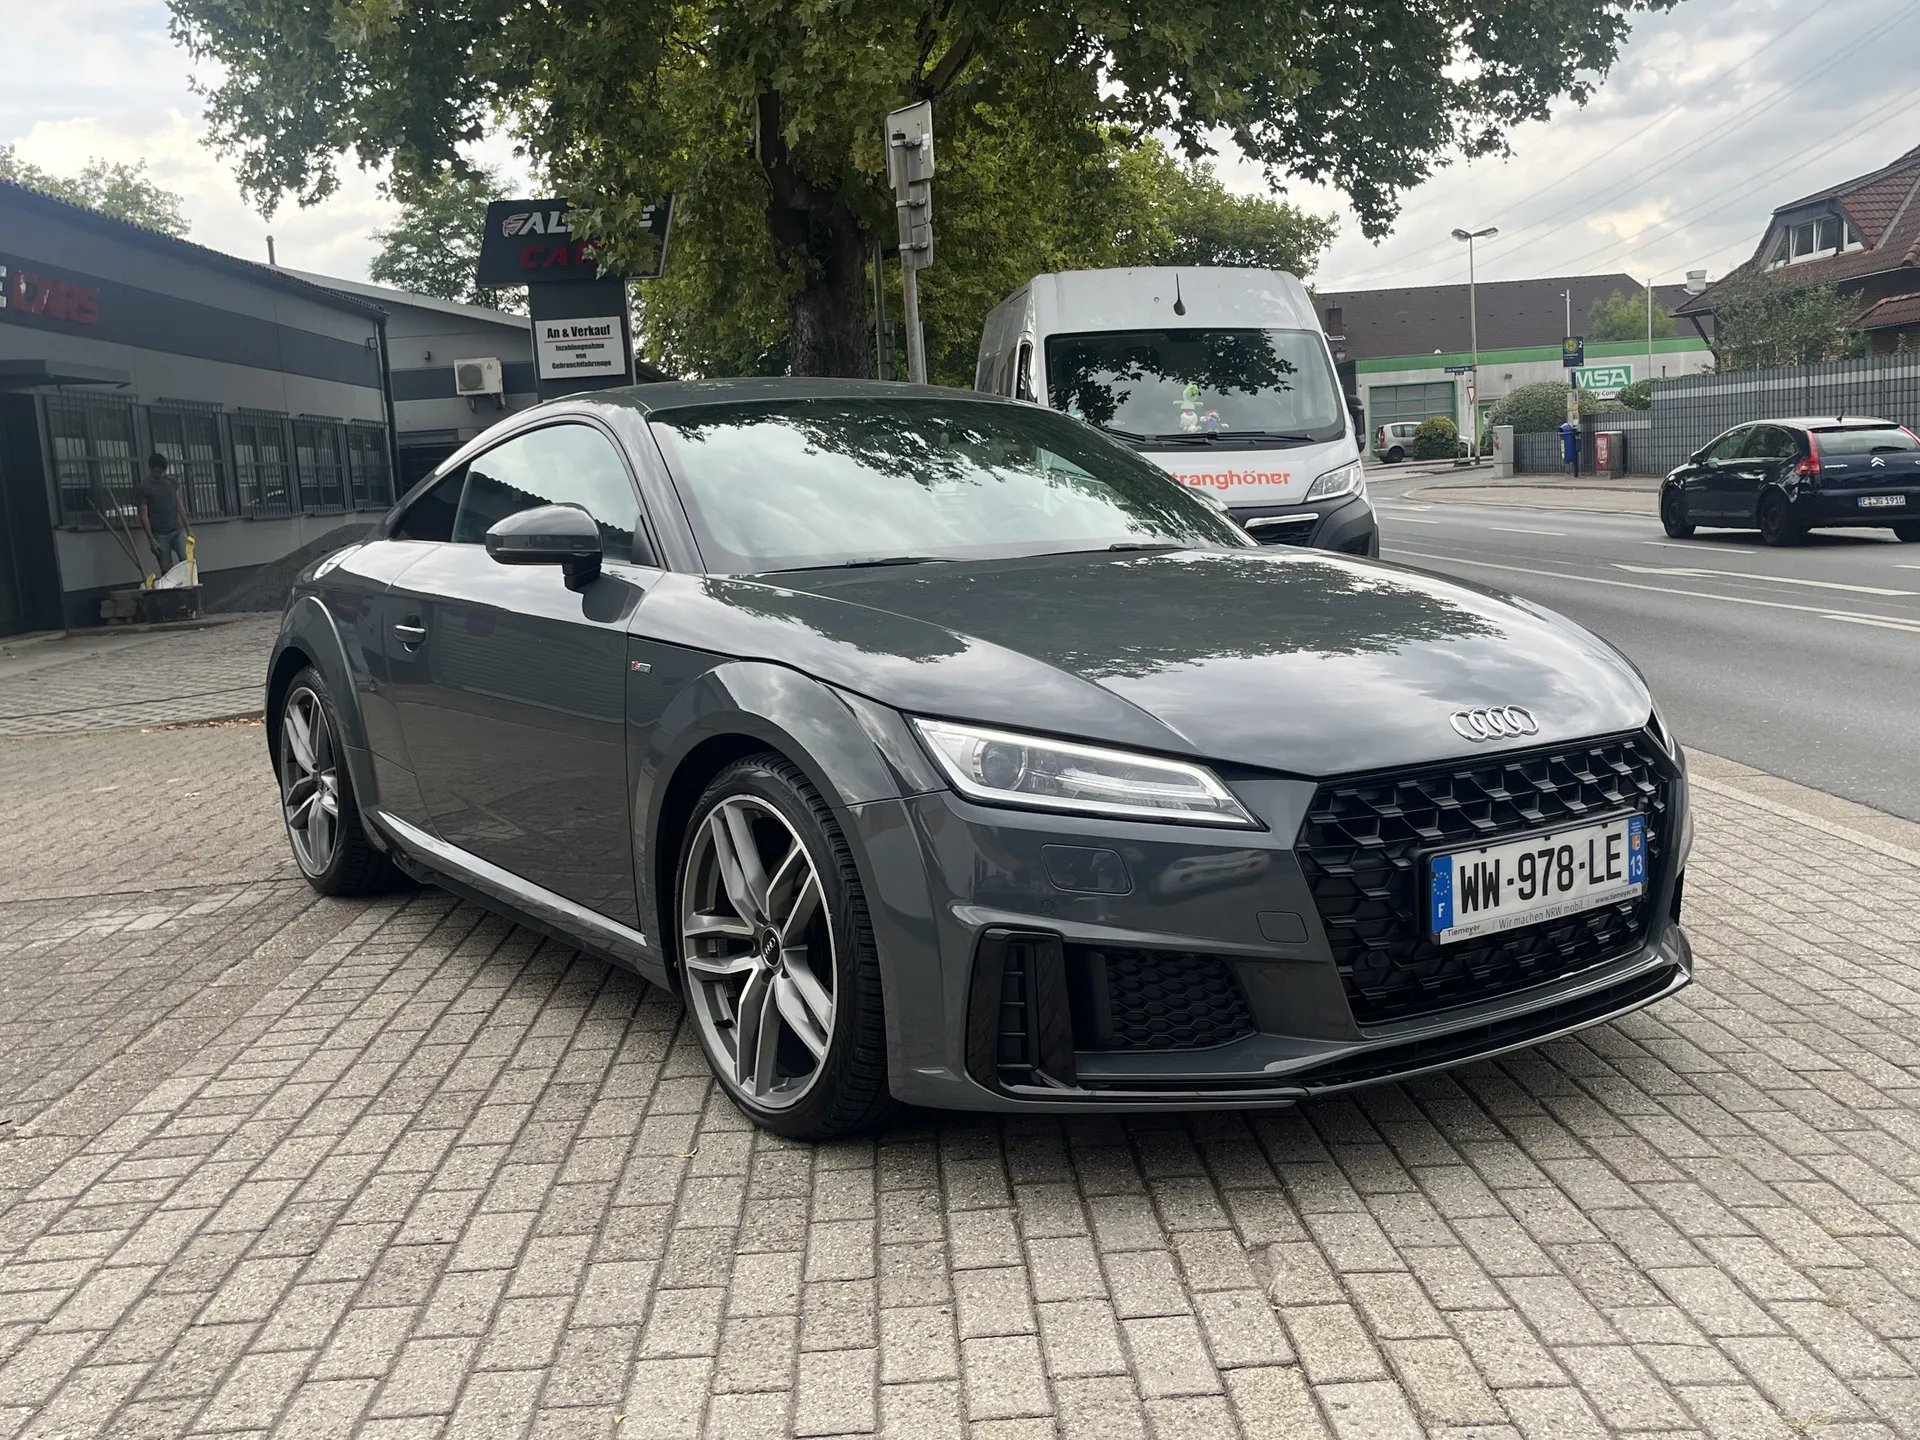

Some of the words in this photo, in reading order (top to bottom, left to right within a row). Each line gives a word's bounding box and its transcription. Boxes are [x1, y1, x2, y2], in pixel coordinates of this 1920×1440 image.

[520, 241, 602, 268] CAR
[547, 328, 560, 339] An
[562, 328, 569, 338] &
[570, 324, 611, 338] Verkauf
[1575, 369, 1628, 387] MSA
[1171, 470, 1291, 490] tranghöner
[1630, 854, 1643, 877] 13
[1595, 887, 1638, 904] www.tiemeyer.de
[1438, 902, 1446, 918] F
[1498, 919, 1512, 930] Wir
[1513, 912, 1544, 926] machen
[1545, 906, 1564, 919] NRW
[1447, 924, 1481, 937] Tiemeyer
